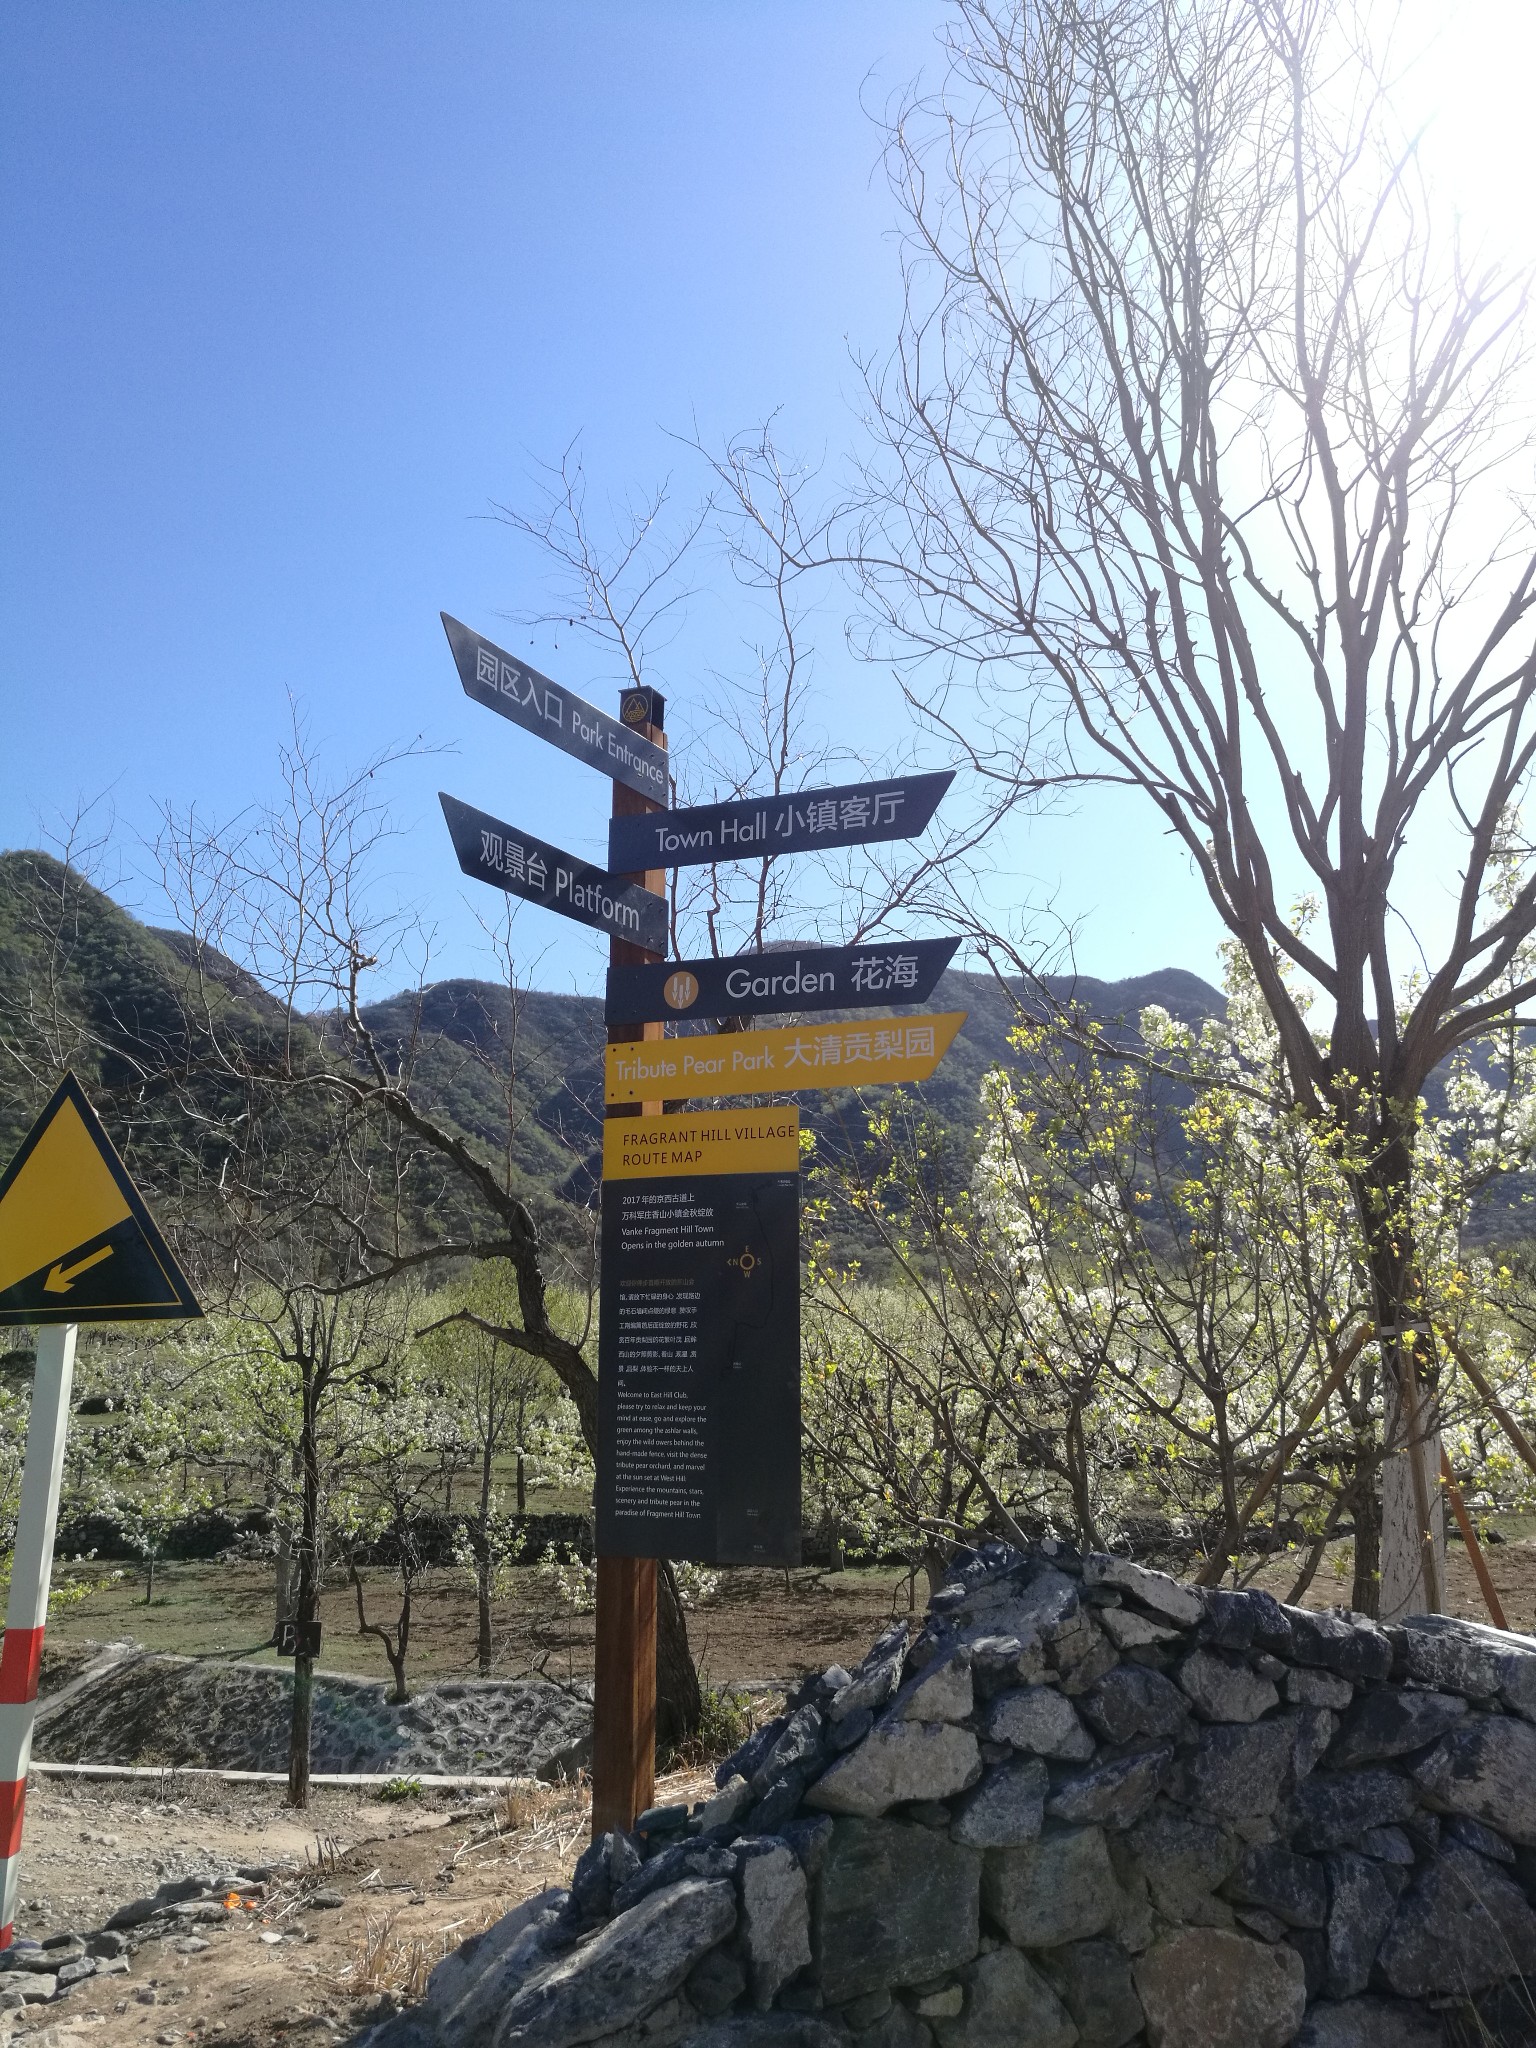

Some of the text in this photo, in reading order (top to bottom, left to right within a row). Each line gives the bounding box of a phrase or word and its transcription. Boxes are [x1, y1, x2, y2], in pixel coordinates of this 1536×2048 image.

[476, 646, 664, 785] 园区入口 Park Entrance
[655, 790, 905, 851] Town Hall 小镇客厅
[479, 829, 640, 931] 观景台 Platform
[725, 955, 918, 998] Garden 花海
[616, 1027, 935, 1081] Tribute Pear Park 大清贡梨园
[624, 1125, 795, 1146] FRAGRANT HILL VILLAGE
[623, 1151, 702, 1165] ROUTE MAP
[622, 1196, 640, 1205] 2017
[621, 1242, 644, 1251] Opens
[668, 1240, 693, 1250] golden
[696, 1239, 724, 1247] autumn
[622, 1225, 714, 1236] Vanke Fragment Hill Town
